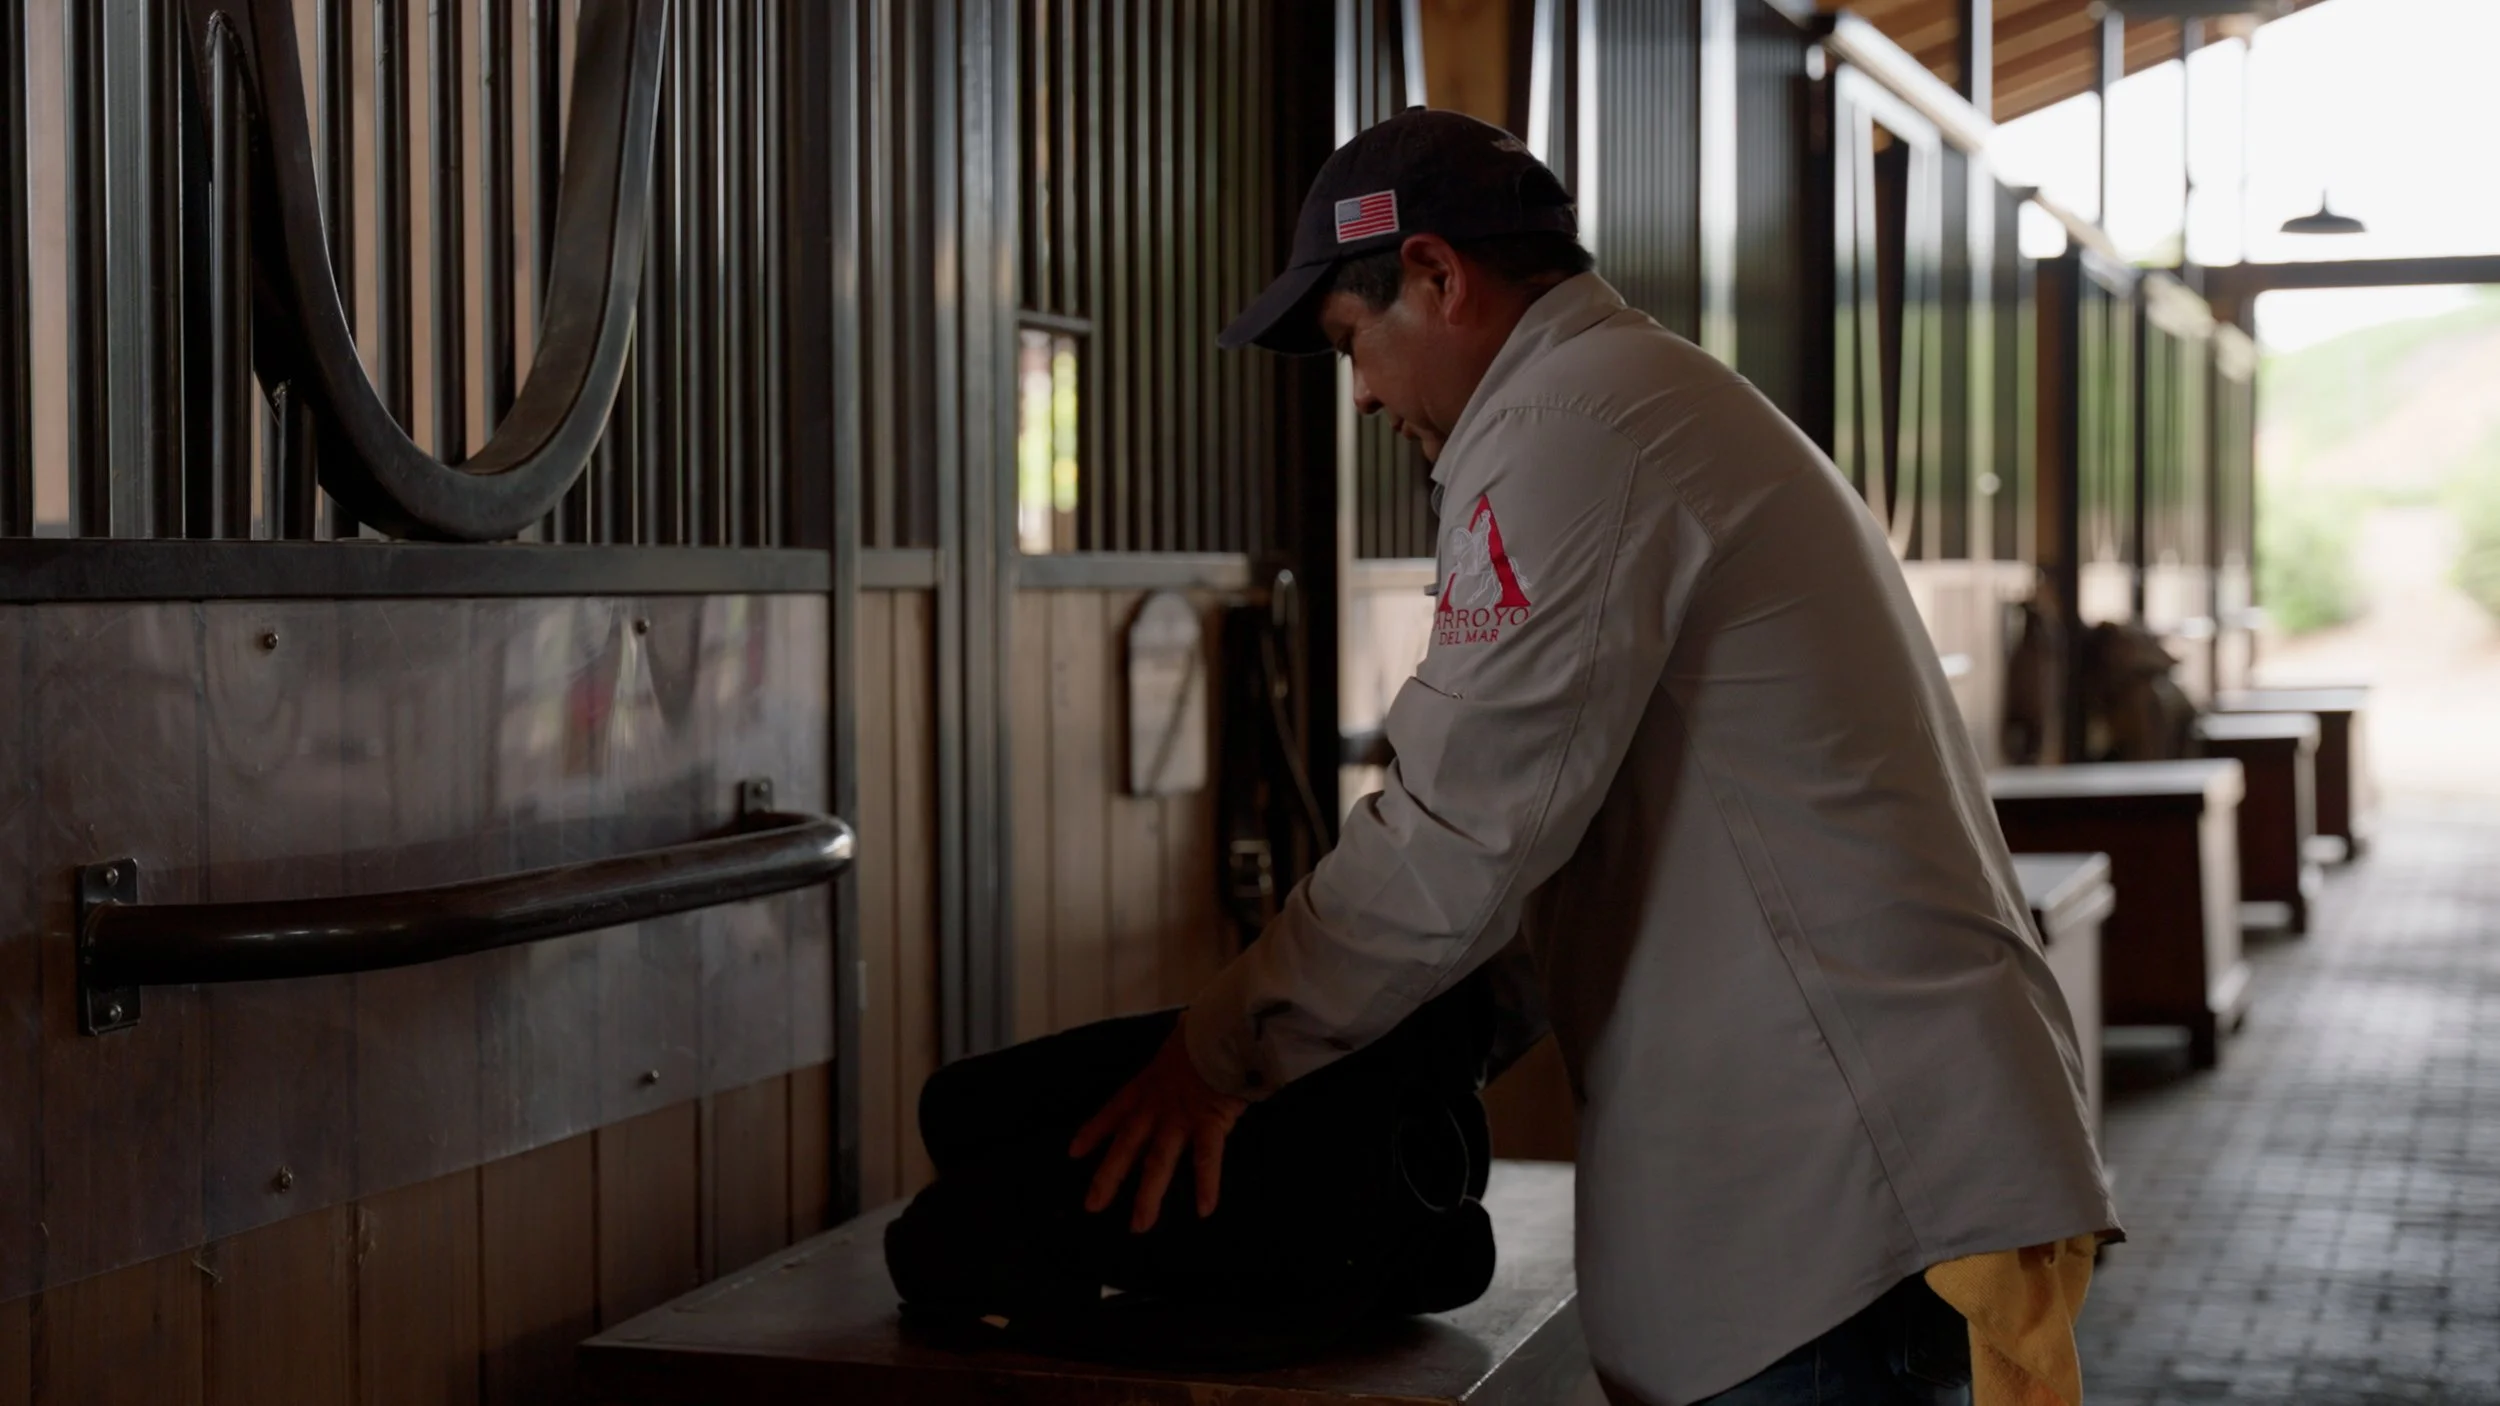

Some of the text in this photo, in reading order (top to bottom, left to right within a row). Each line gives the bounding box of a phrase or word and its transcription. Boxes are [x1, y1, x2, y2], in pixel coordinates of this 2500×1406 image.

[1435, 607, 1529, 630] ARROYO
[1439, 629, 1499, 645] DEL MAR
